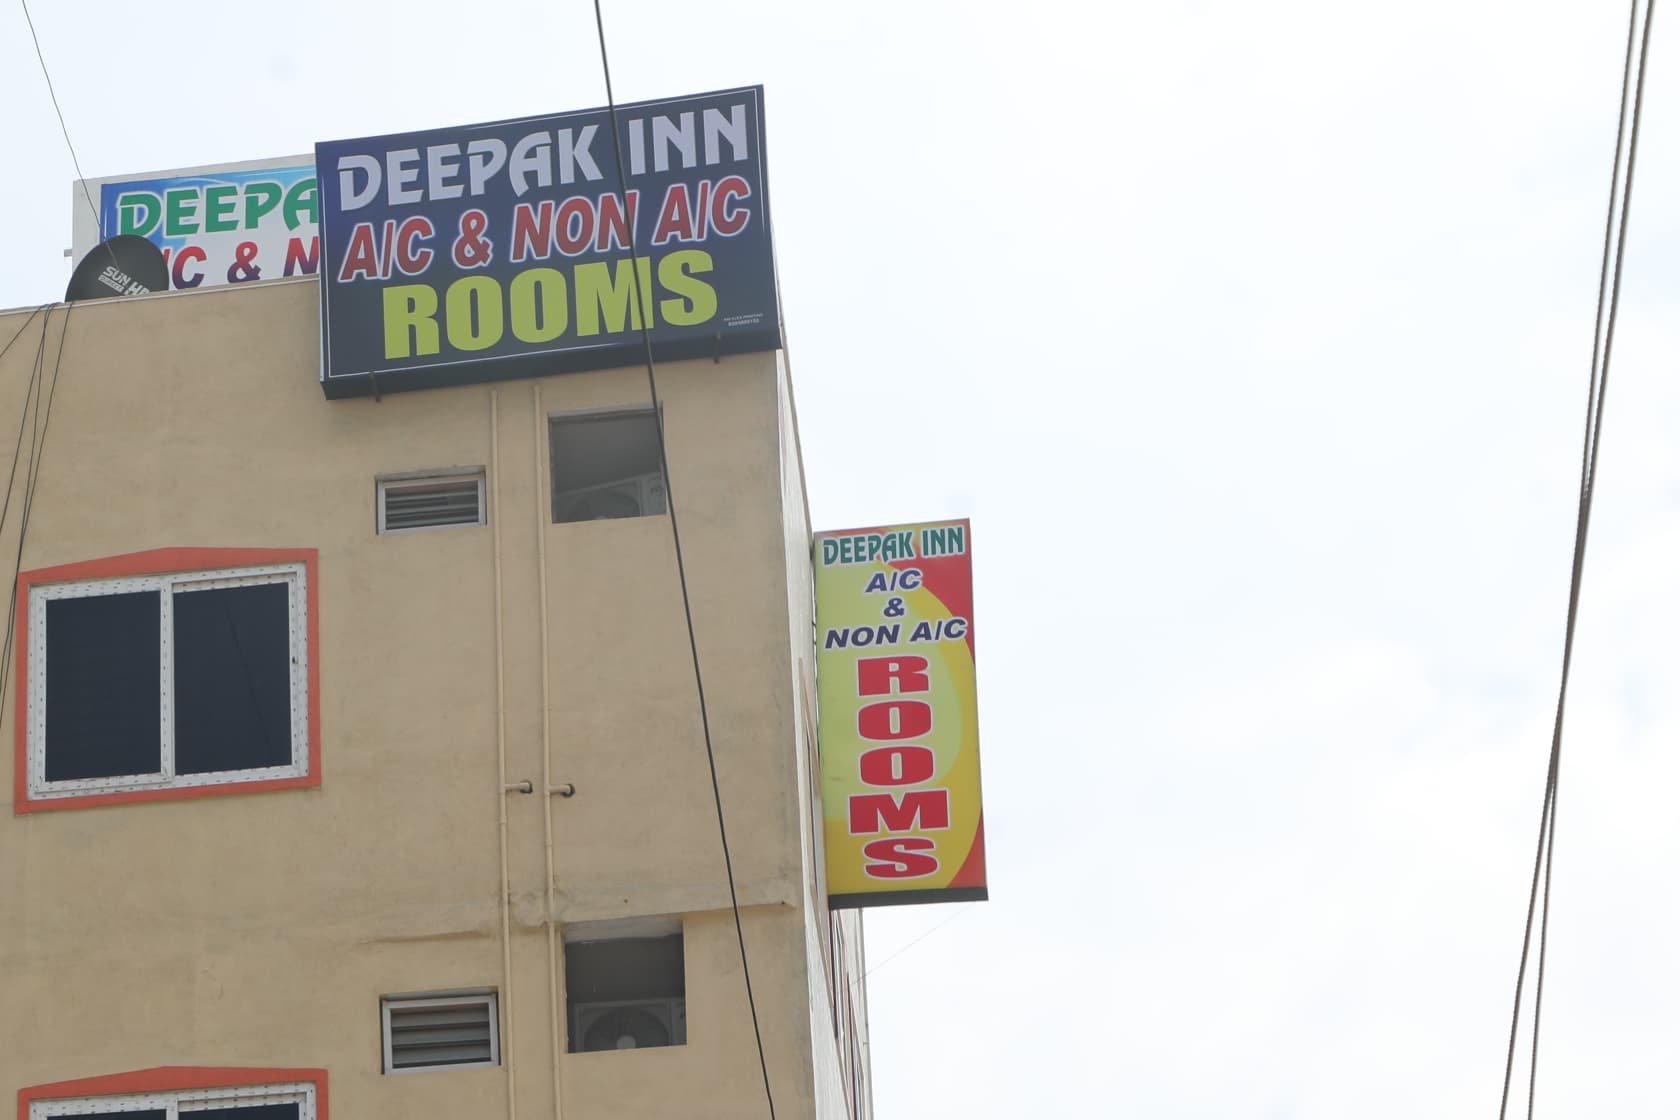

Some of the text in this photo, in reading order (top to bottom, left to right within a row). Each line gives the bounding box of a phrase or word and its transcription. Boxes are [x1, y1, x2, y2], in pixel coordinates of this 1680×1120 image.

[336, 104, 749, 211] DEEPAK INN
[338, 175, 752, 282] A/C & NON A/C
[102, 265, 132, 286] SUN
[226, 241, 262, 284] &
[383, 250, 718, 359] ROOMS
[822, 526, 965, 565] DEEPAK INN
[864, 569, 922, 593] A/C
[883, 597, 906, 618] &
[824, 618, 969, 649] NON A/C
[848, 655, 950, 879] ROOMS
